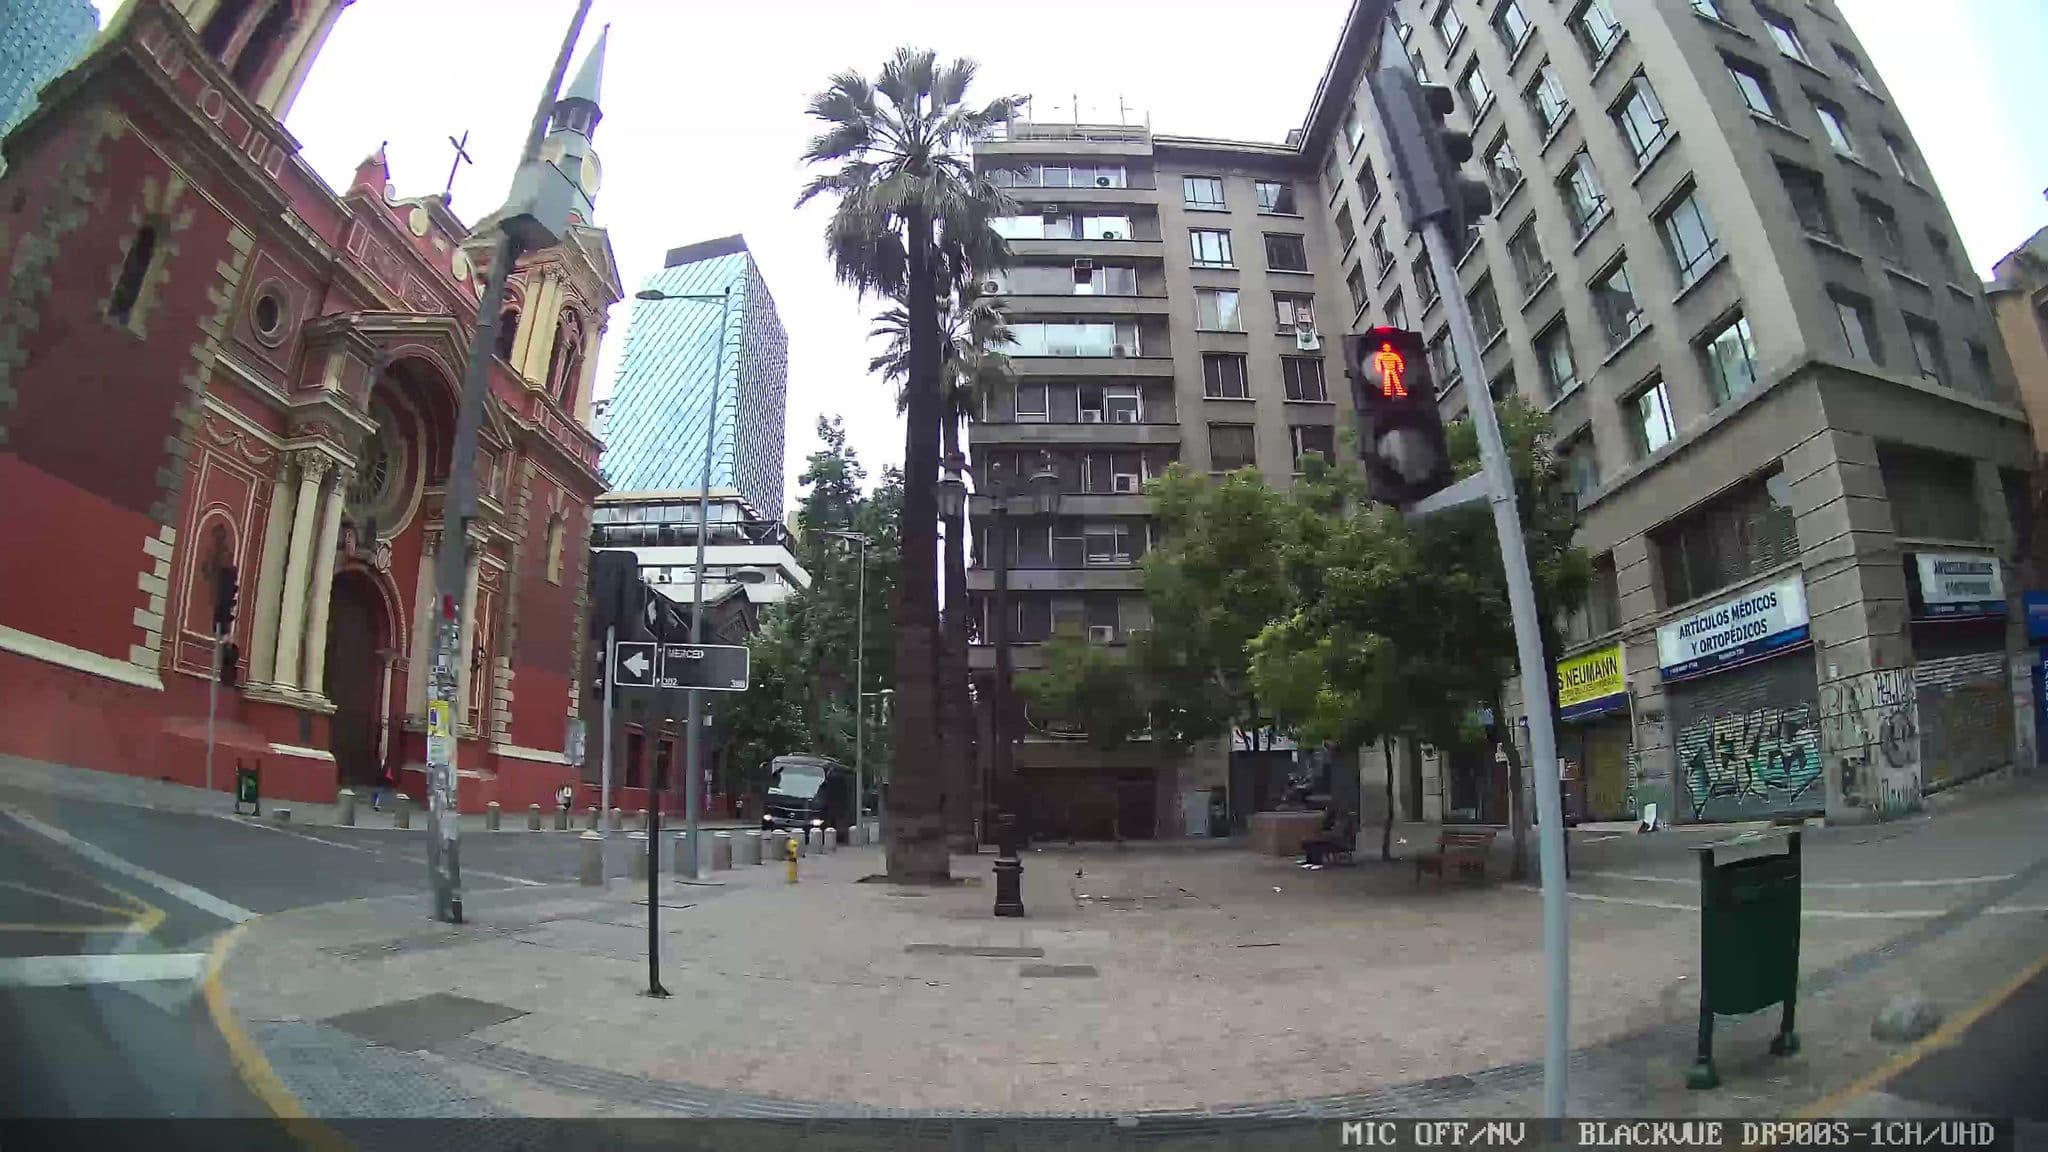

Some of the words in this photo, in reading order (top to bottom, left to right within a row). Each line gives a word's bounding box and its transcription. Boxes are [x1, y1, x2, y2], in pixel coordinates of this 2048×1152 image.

[1679, 610, 1730, 640] ARTÍCULOS
[1731, 592, 1777, 621] MÉDICOS
[1691, 642, 1699, 656] Y
[1700, 618, 1768, 653] ORTOPÉDICOS
[1565, 655, 1618, 689] NEUMANN
